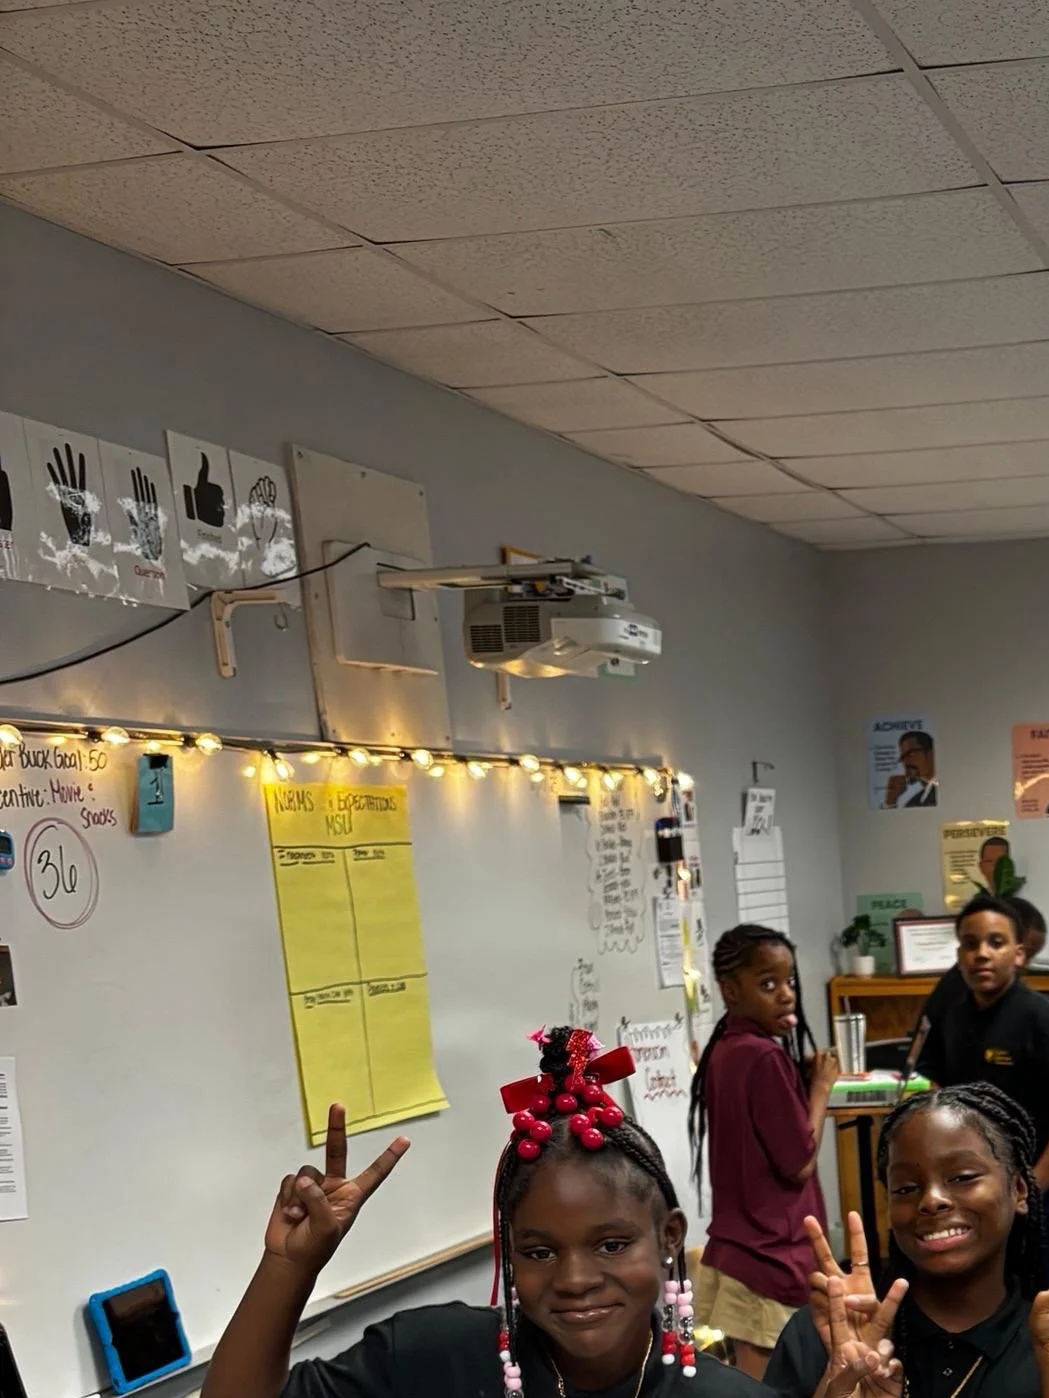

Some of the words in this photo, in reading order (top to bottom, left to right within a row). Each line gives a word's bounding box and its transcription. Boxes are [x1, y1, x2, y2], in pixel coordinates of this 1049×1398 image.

[873, 719, 923, 732] ACHIEVE
[943, 825, 1007, 840] PERSEVERE
[37, 845, 78, 900] 36
[871, 898, 907, 910] PEACE
